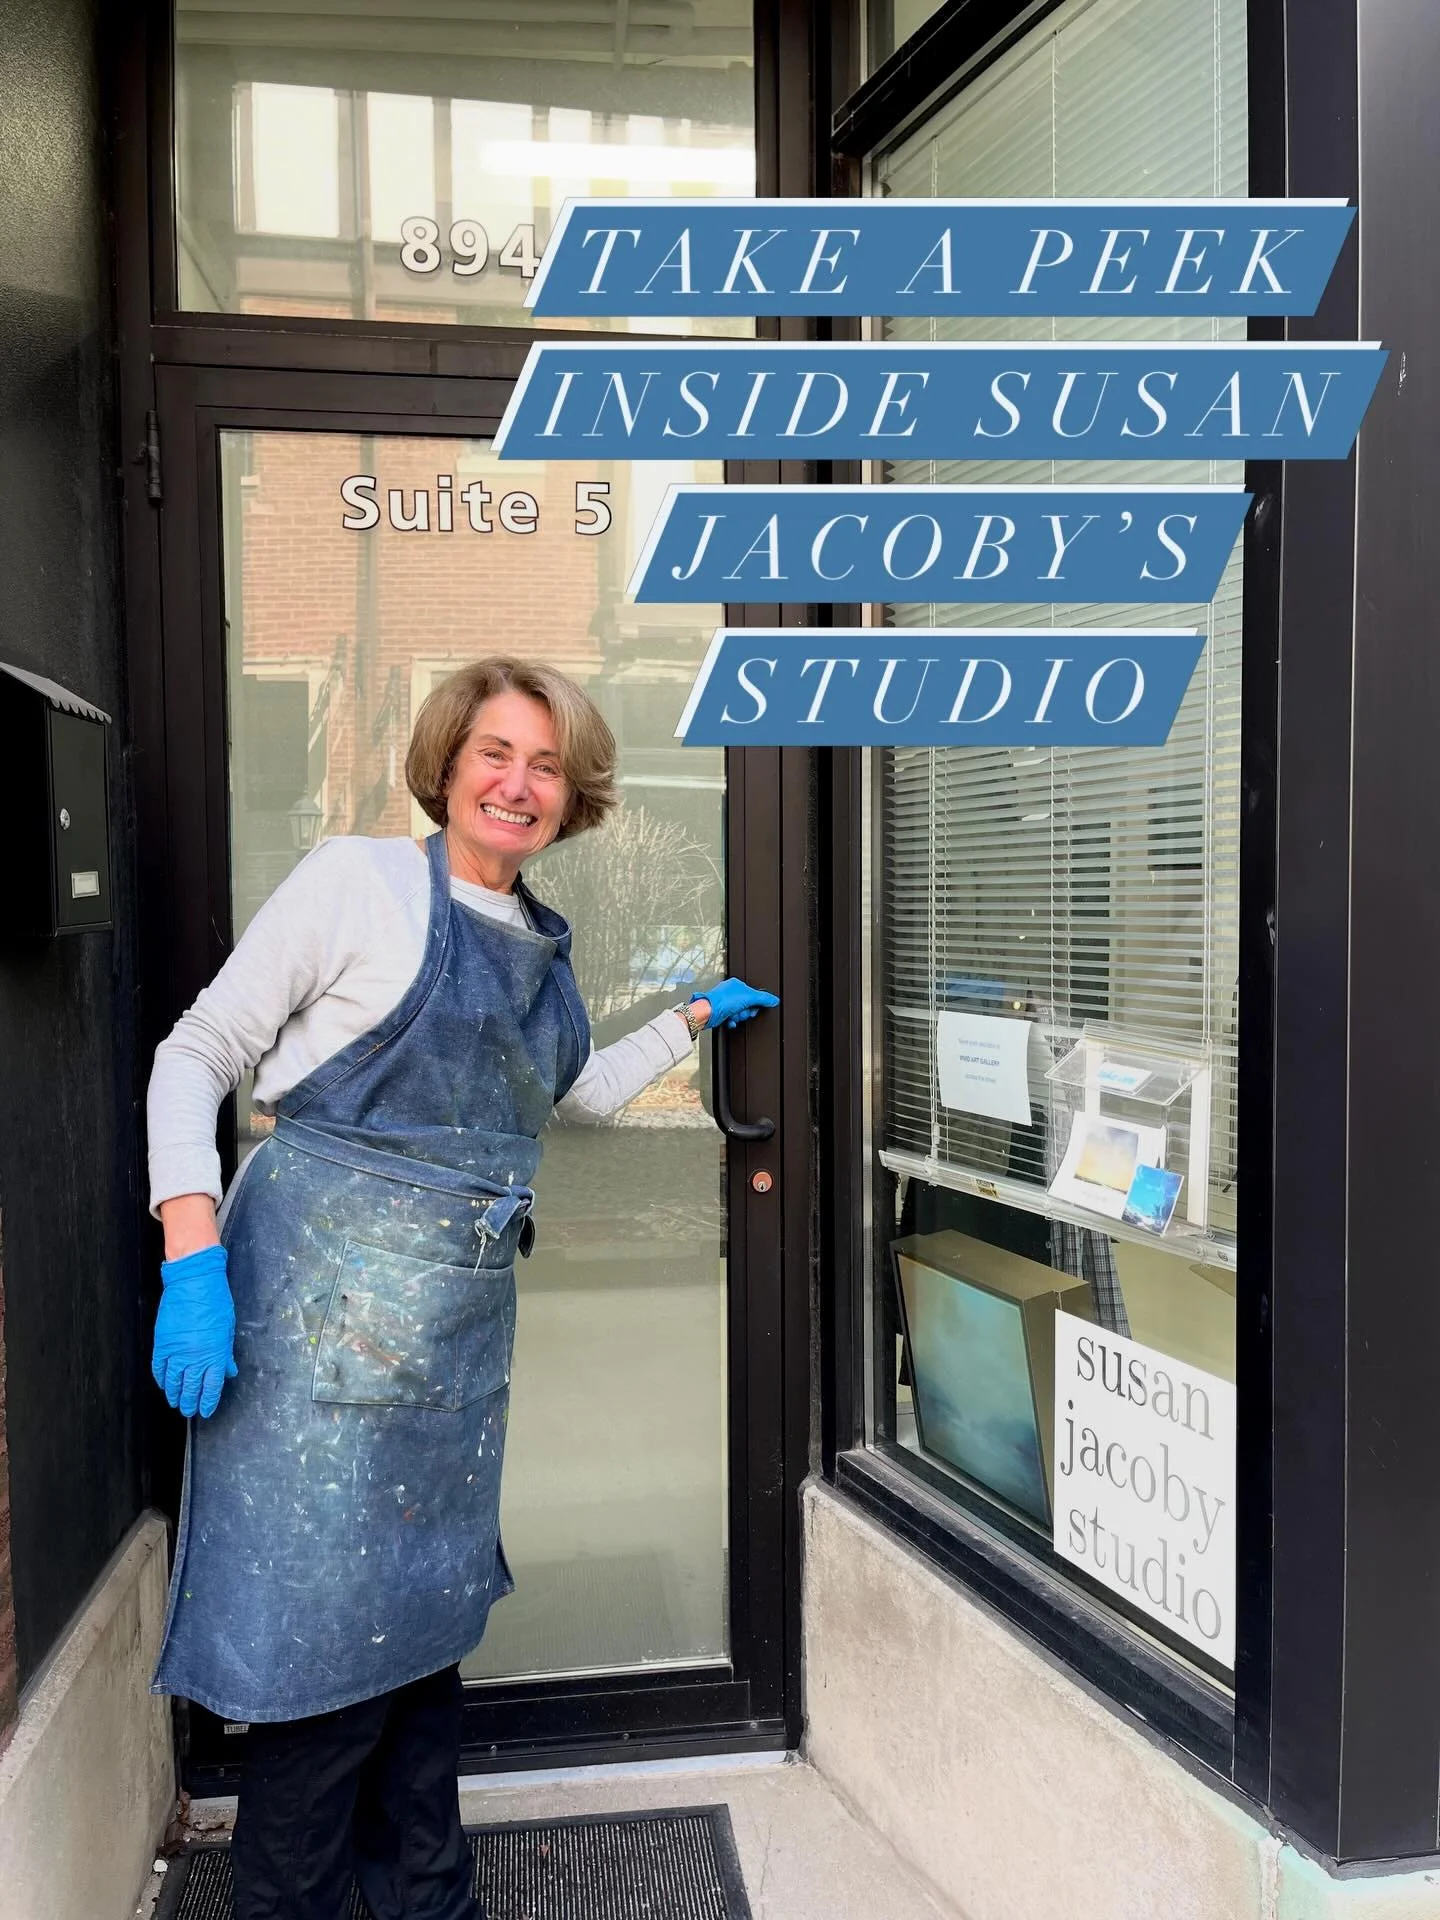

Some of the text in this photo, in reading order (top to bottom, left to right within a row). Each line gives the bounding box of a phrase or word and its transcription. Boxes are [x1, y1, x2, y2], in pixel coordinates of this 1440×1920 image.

[400, 216, 541, 278] 894
[340, 474, 613, 535] Suite 5
[1076, 1336, 1215, 1441] susan
[1060, 1399, 1226, 1555] jacoby
[1069, 1506, 1222, 1641] studio
